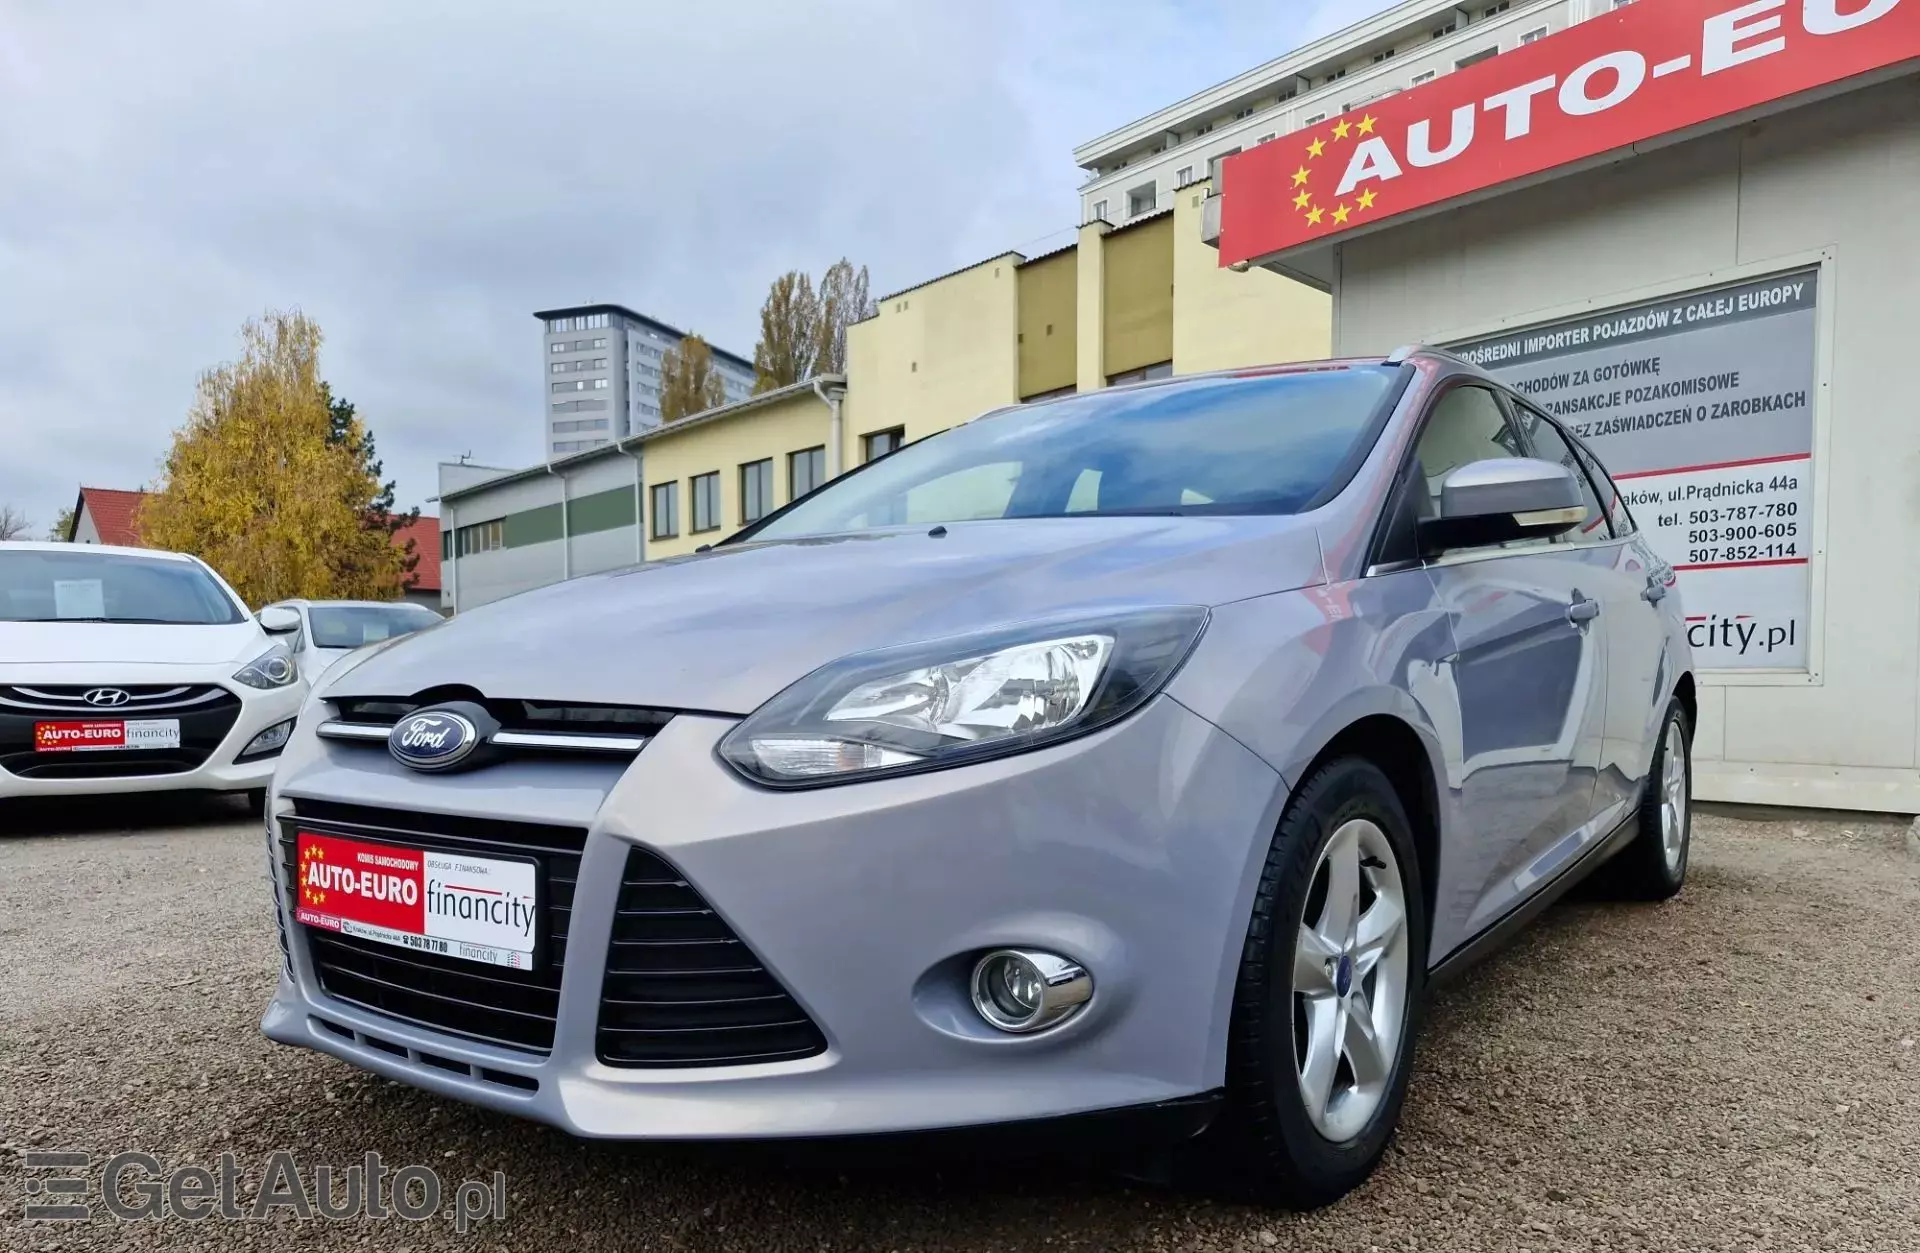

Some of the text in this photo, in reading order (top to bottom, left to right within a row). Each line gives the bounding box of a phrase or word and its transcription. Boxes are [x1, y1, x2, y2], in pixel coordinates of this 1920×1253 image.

[1523, 327, 1590, 355] IMPORTER
[1593, 310, 1669, 340] POJAZDÓW
[1673, 307, 1683, 325] Z
[1686, 298, 1734, 323] CAŁEJ
[1738, 282, 1804, 313] EUROPY
[1573, 370, 1590, 387] ZA
[1594, 356, 1661, 383] GOTÓWKĘ
[1625, 371, 1740, 406] POZAKOMISOWE
[1595, 404, 1693, 437] ZAŚWIADCZEŃ
[1696, 405, 1707, 422] O
[1711, 390, 1806, 420] ZAROBKACH
[1667, 478, 1764, 502] ul.Prądnicka
[1768, 475, 1798, 492] 44a
[1658, 501, 1798, 527] tel. 503-787-780
[1688, 522, 1798, 544] 503-900-605
[1688, 542, 1797, 563] 507-852-114
[43, 728, 121, 740] AUTO-EURO
[126, 727, 179, 739] financity
[401, 717, 451, 749] Ford
[357, 852, 419, 871] KOMIS SAMOCHODOWY
[308, 862, 418, 906] AUTO-EURO
[427, 878, 535, 937] financity
[300, 911, 340, 930] AUTO-EURO
[410, 935, 423, 950] 503
[423, 938, 432, 951] 78
[432, 940, 439, 952] 77
[439, 941, 449, 954] 80
[459, 942, 499, 965] financity
